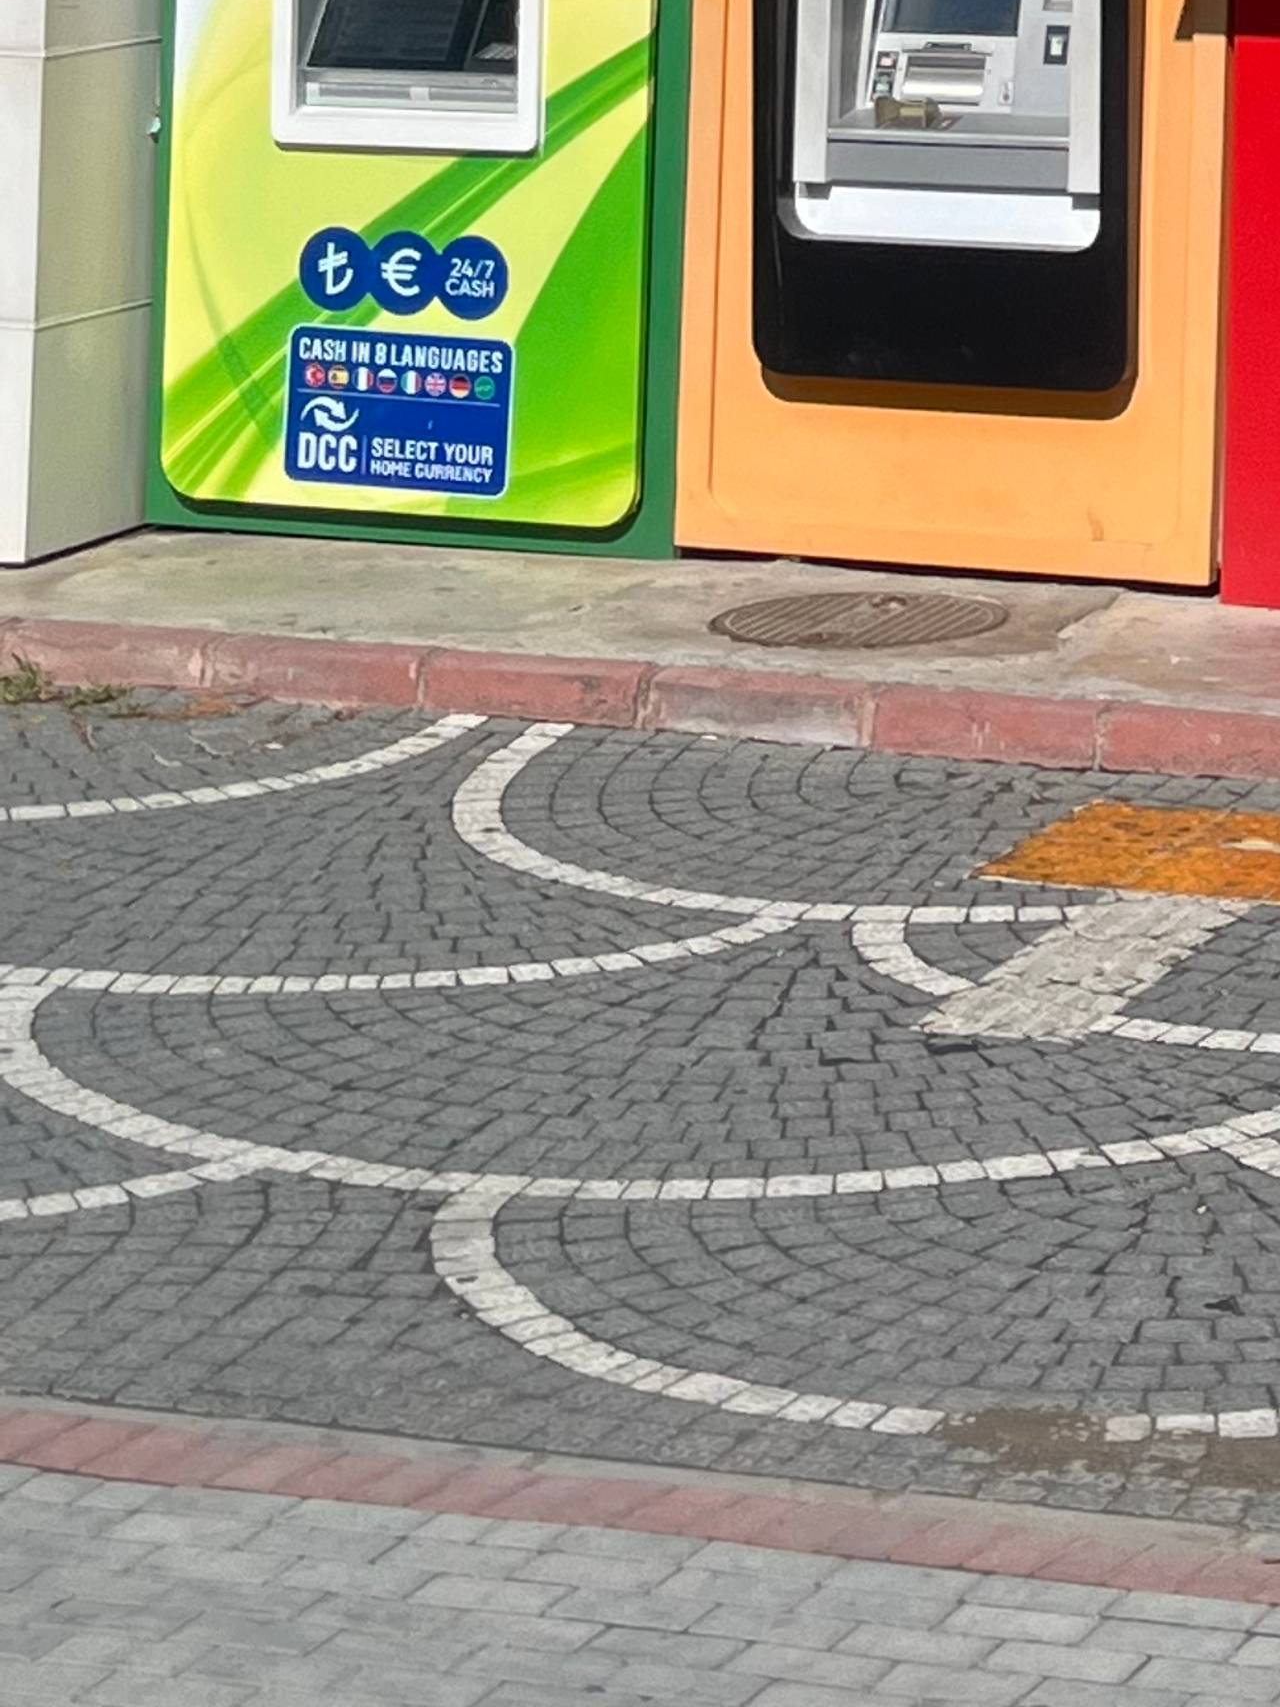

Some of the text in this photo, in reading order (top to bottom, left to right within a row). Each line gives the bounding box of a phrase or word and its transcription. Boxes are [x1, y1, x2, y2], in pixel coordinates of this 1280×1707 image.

[381, 247, 422, 297] €
[450, 258, 495, 279] 24/7
[445, 277, 495, 298] CASH
[300, 337, 504, 374] CASH IN 8 LANGUAGES
[297, 431, 358, 473] DCC
[371, 437, 494, 467] SELECT YOUR
[370, 458, 493, 484] HOME CURRENCY
